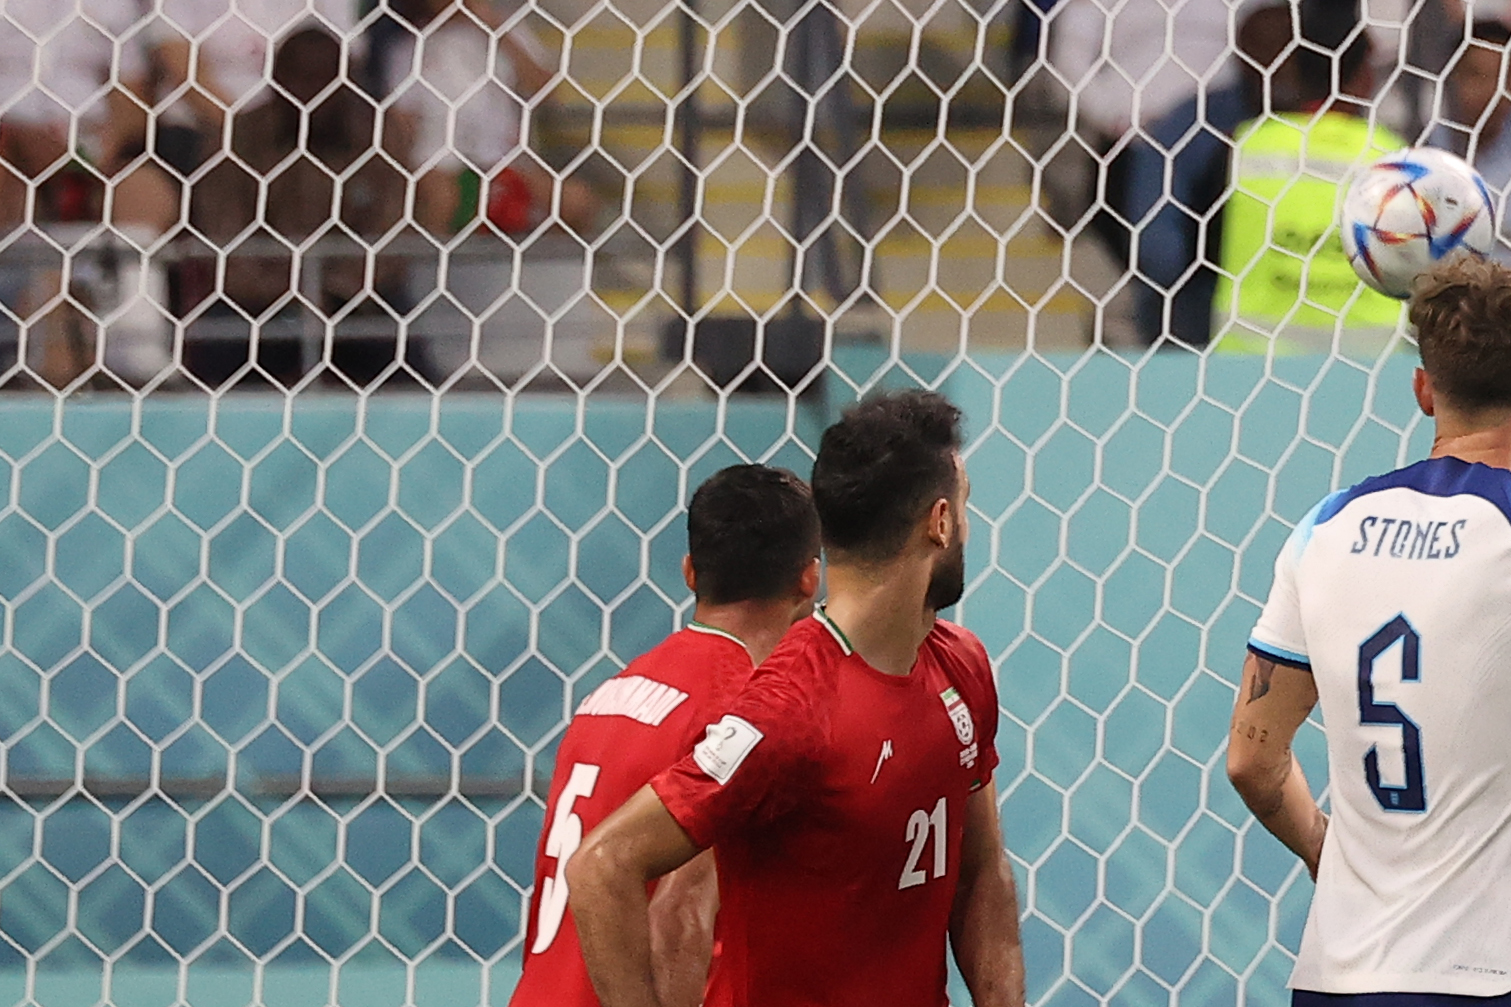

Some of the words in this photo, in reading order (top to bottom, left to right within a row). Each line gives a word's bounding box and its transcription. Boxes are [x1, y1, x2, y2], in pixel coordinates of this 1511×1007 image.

[1350, 515, 1468, 559] STONES
[1358, 611, 1427, 814] 5
[531, 762, 600, 955] 5
[898, 796, 947, 890] 21
